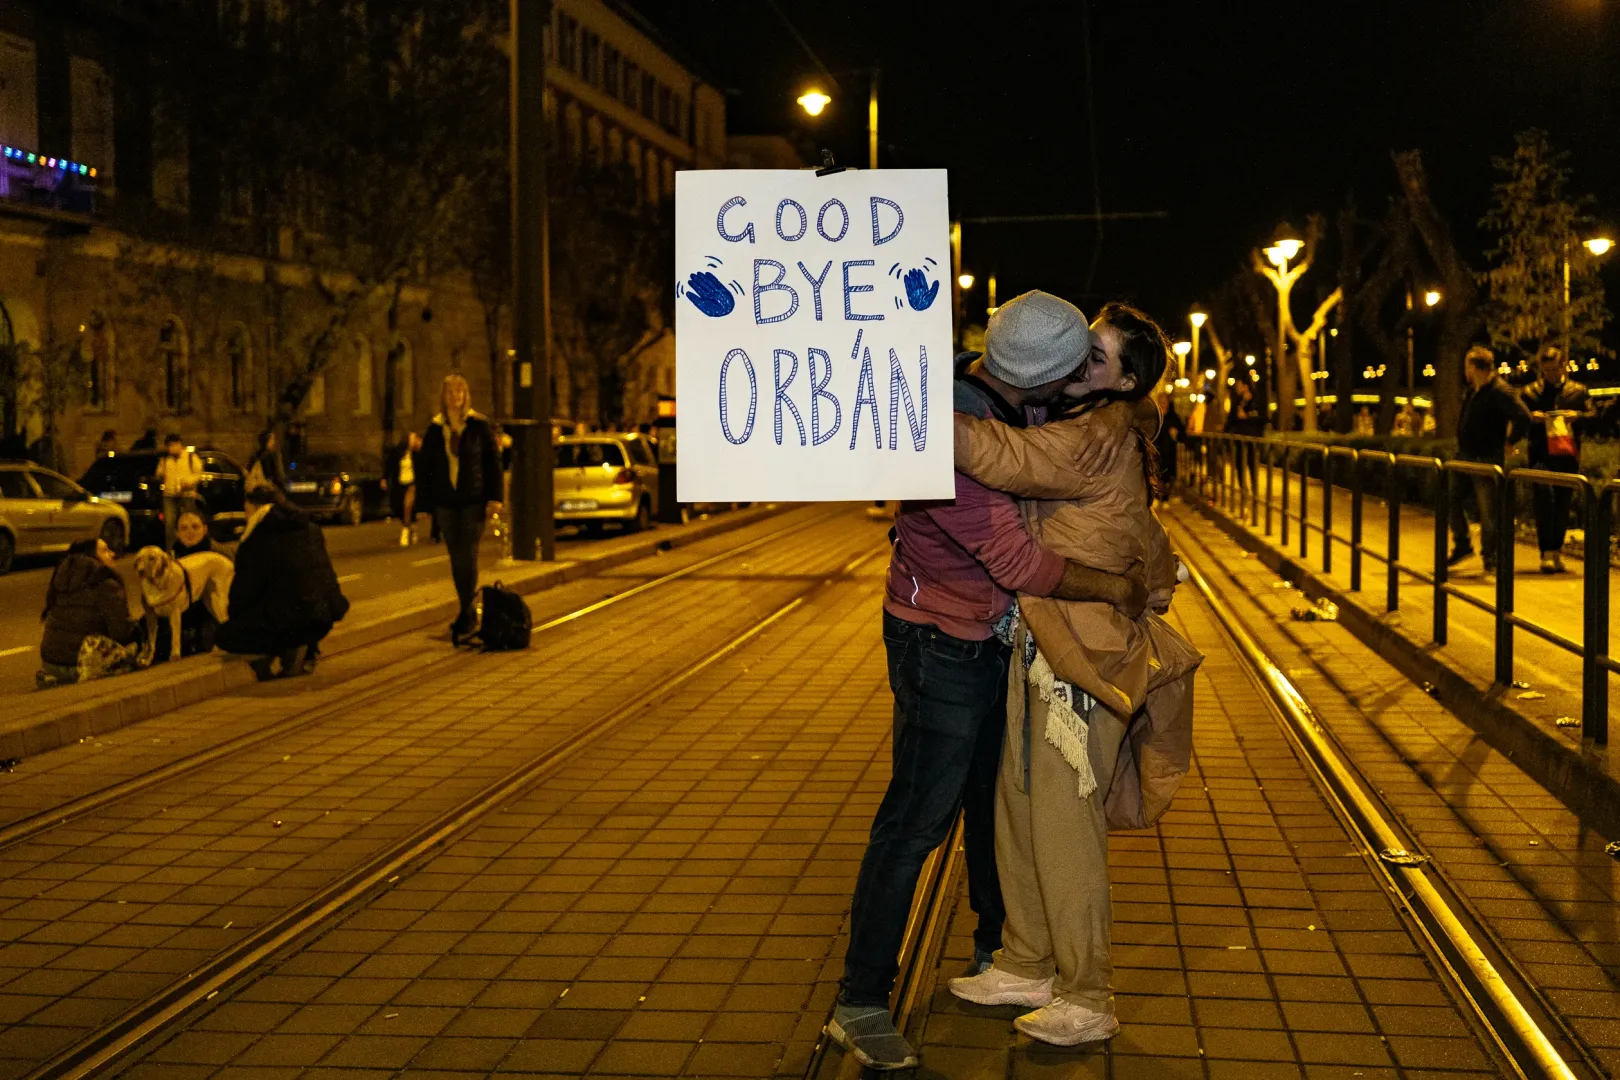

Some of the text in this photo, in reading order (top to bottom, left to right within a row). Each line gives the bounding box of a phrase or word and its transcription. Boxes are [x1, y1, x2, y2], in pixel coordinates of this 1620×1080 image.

[717, 196, 904, 246] GOOD
[753, 259, 885, 324] BYE
[719, 328, 928, 452] ORBÁN
